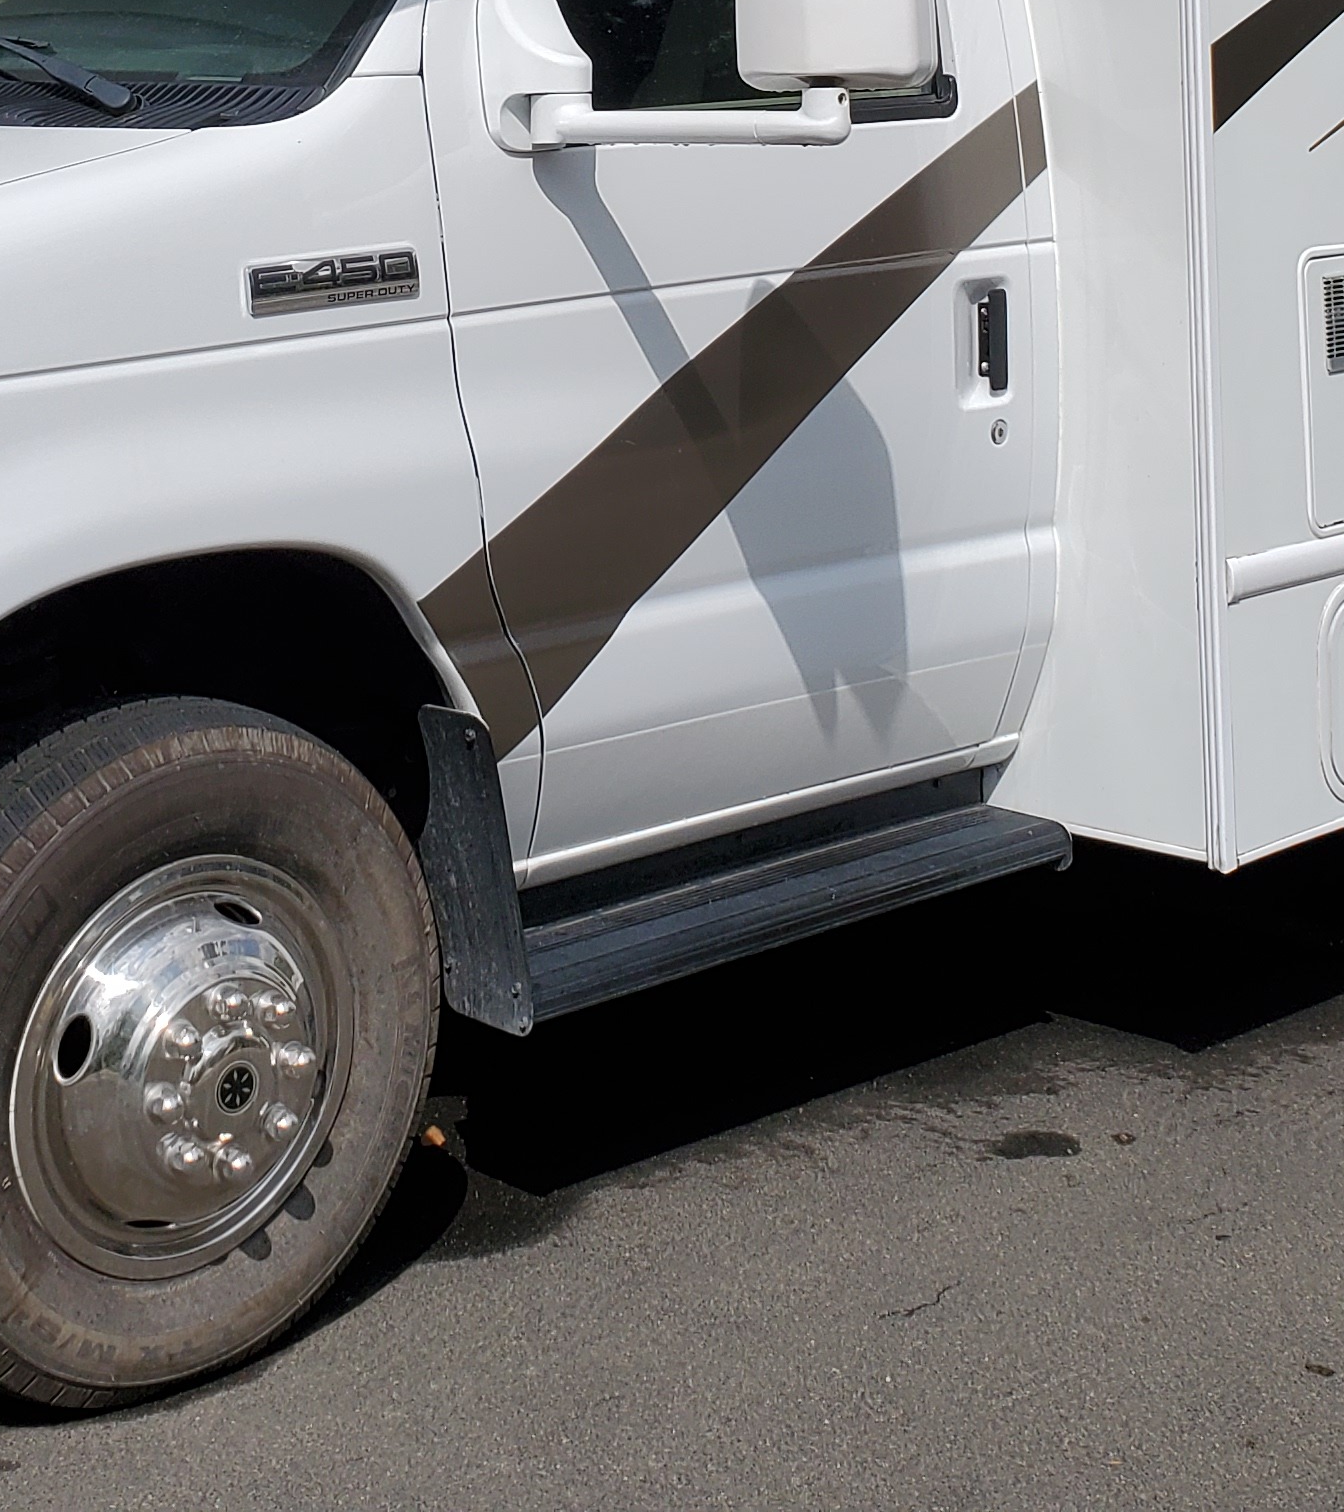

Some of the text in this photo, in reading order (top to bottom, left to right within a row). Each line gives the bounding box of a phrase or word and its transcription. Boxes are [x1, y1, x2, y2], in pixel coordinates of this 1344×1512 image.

[250, 250, 416, 299] E-450
[327, 284, 416, 303] SUPER DUTY
